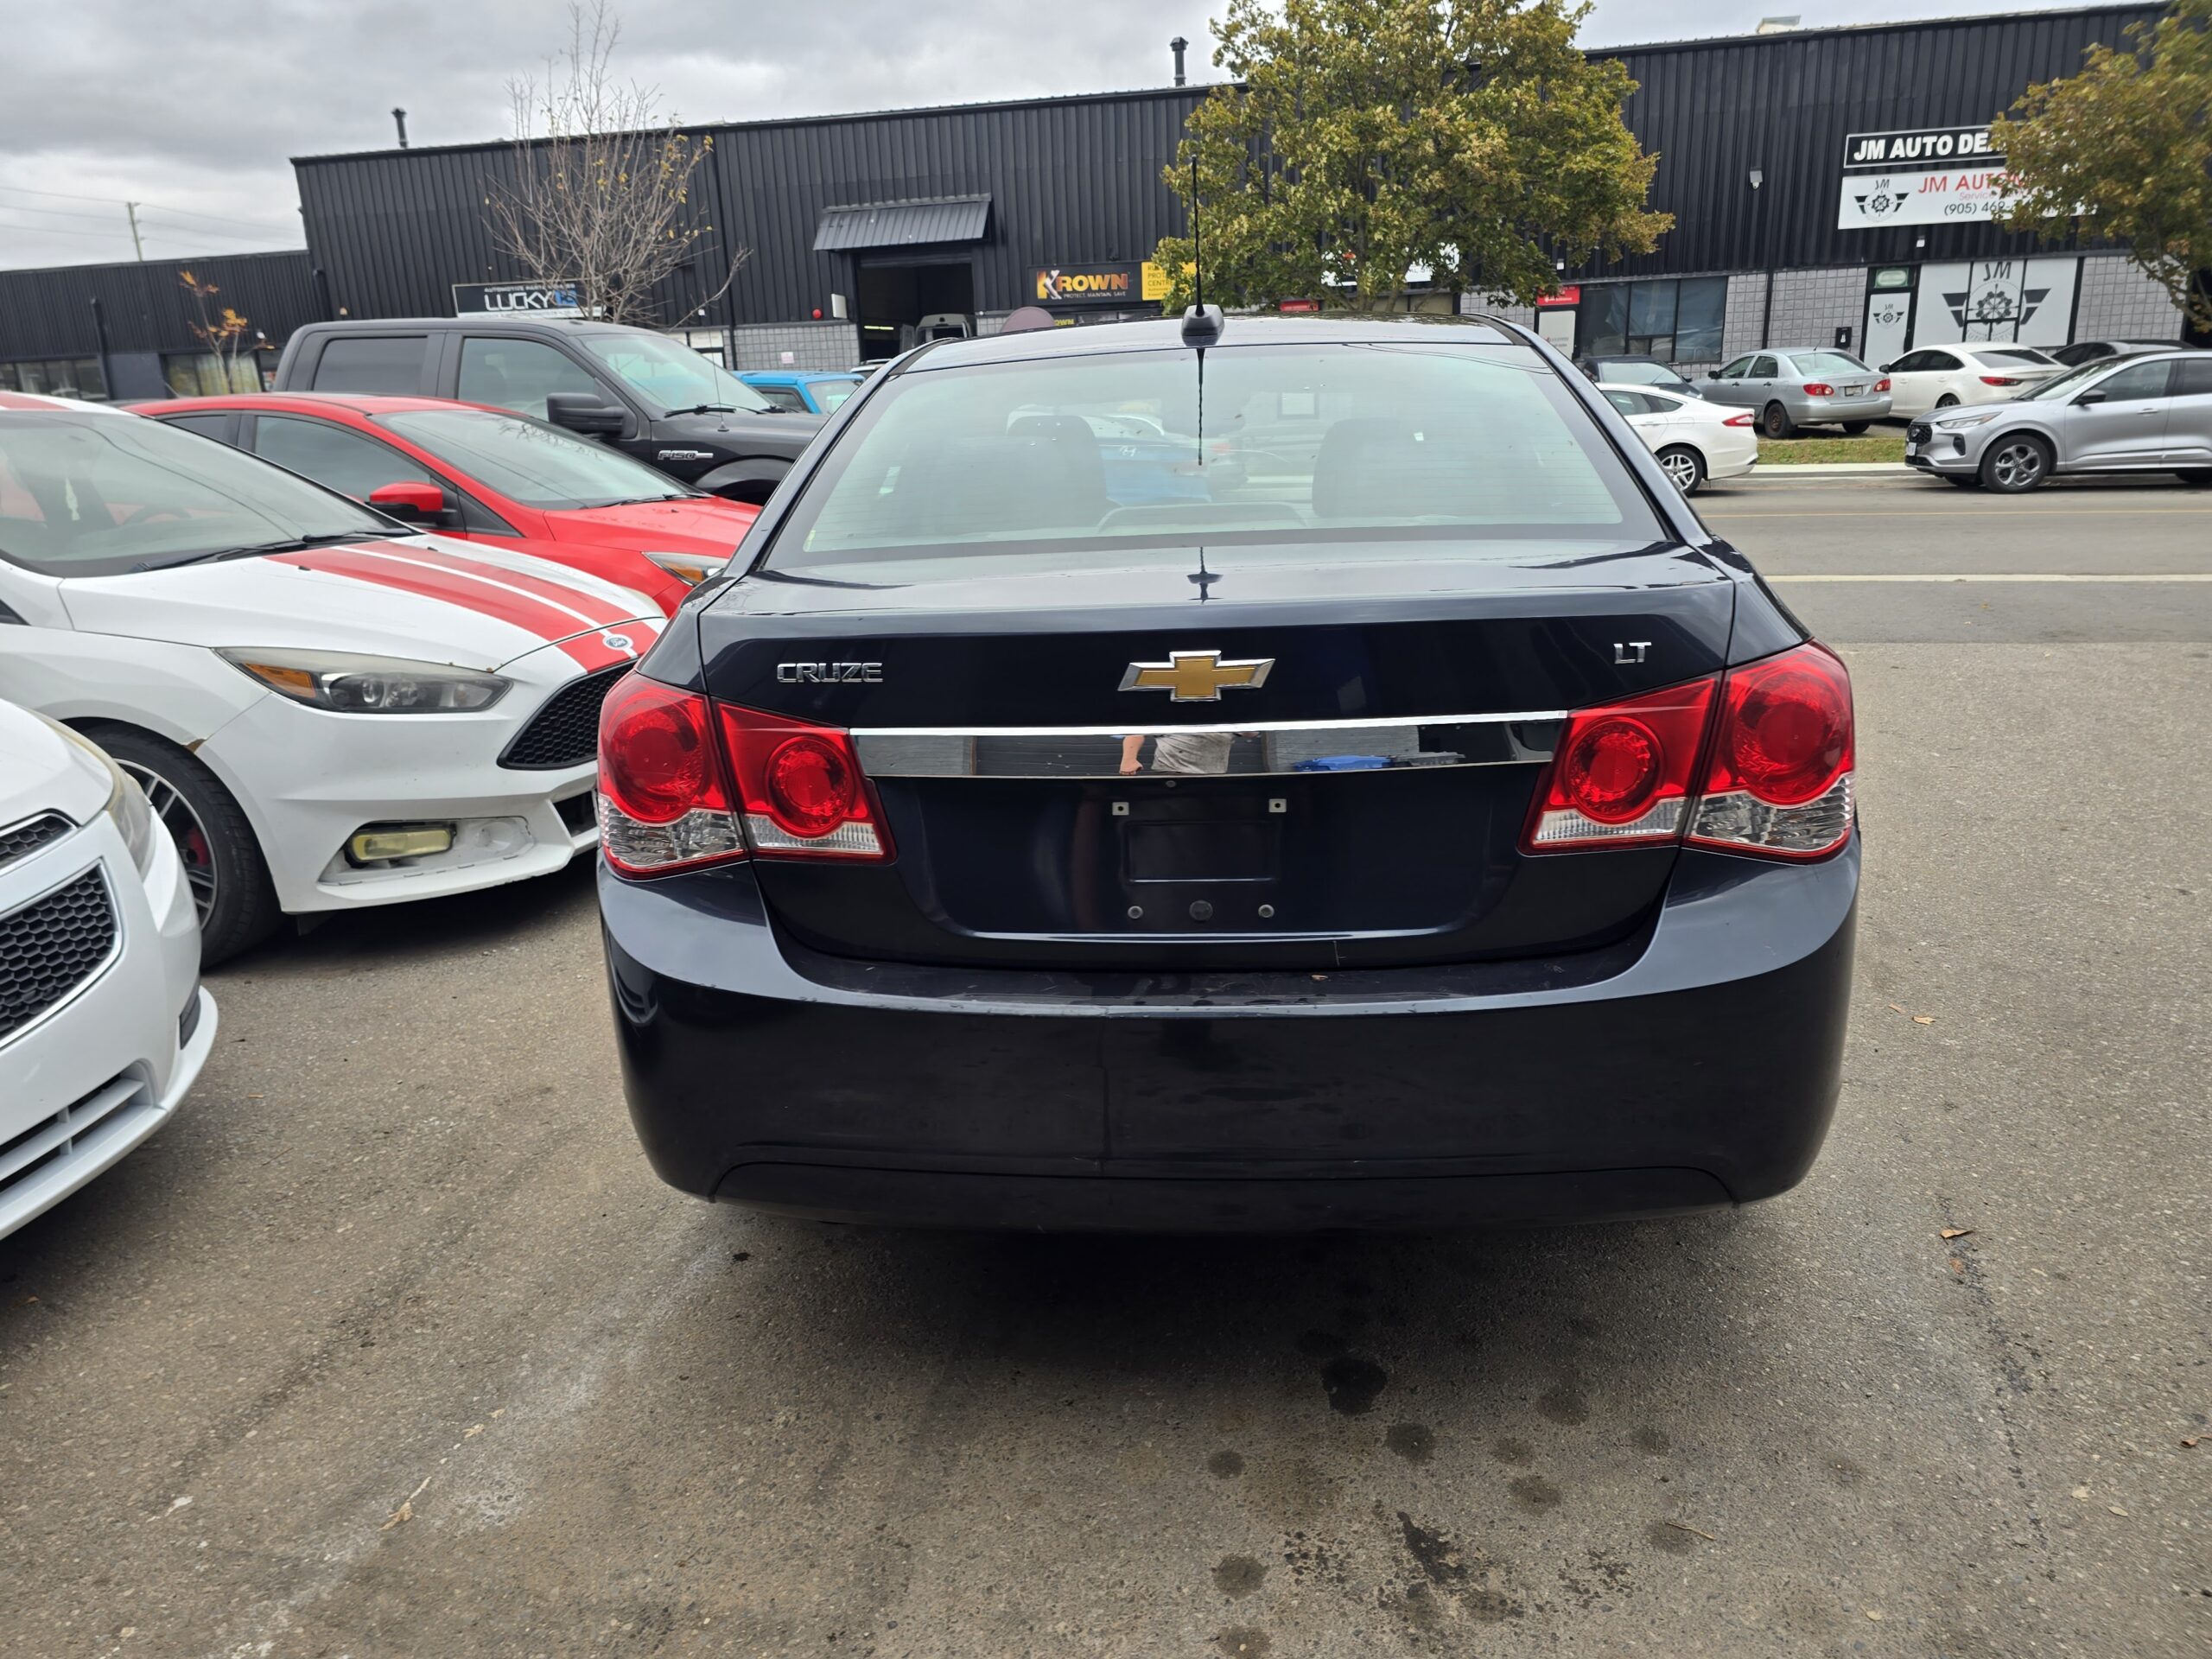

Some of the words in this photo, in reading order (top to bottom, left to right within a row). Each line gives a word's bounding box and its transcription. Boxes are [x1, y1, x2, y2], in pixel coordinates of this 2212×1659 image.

[1853, 139, 1886, 162] JM
[1889, 135, 1954, 159] AUTO
[1918, 175, 1948, 194] JM
[1944, 202, 1978, 215] (905)
[1037, 270, 1128, 300] KROWN
[1054, 318, 1075, 327] OWN
[1613, 641, 1652, 664] LT
[777, 662, 884, 683] CRUZE
